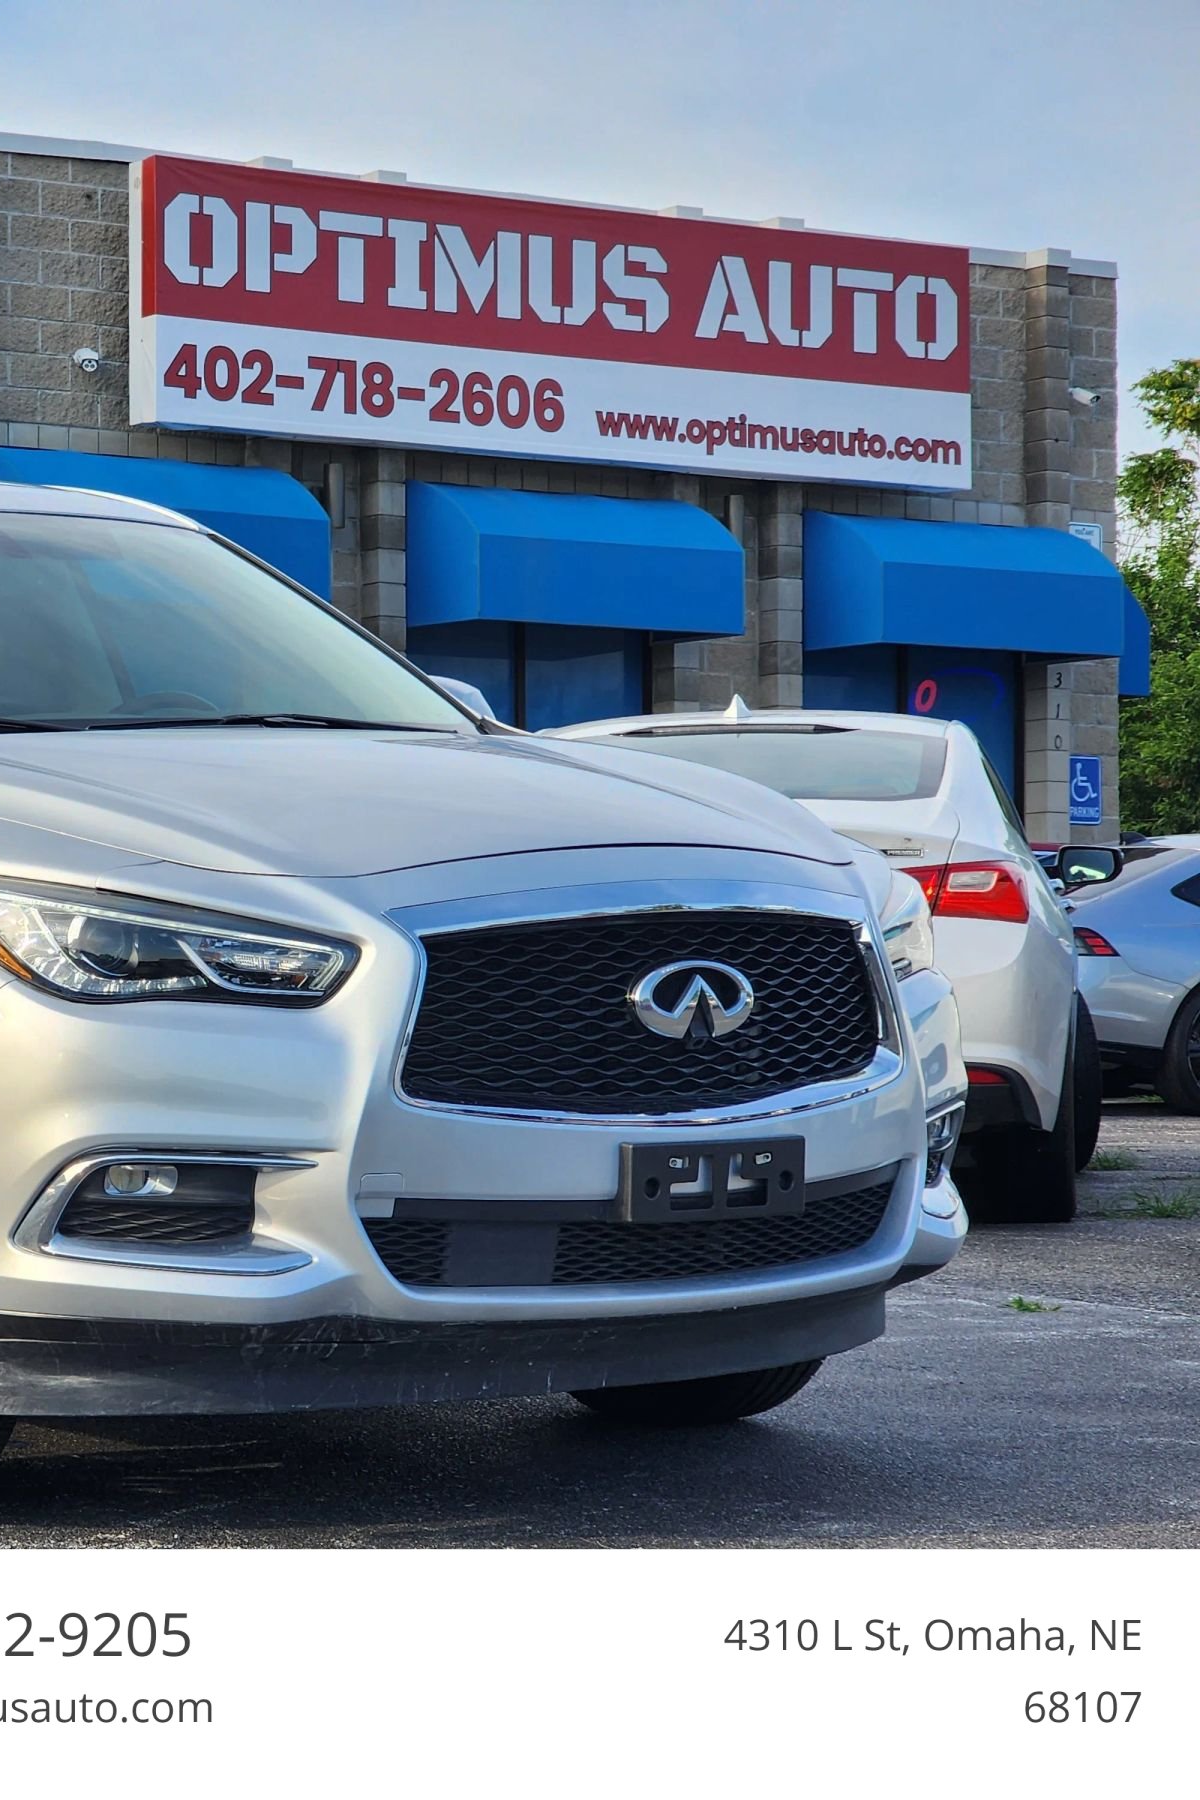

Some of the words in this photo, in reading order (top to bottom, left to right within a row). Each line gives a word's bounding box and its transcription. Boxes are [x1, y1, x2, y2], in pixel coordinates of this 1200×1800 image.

[164, 192, 669, 334] OPTIMUS
[695, 256, 959, 361] AUTO
[163, 343, 566, 433] 402-718-2606
[596, 410, 962, 466] www.optimusauto.com
[1070, 806, 1099, 818] PARKING
